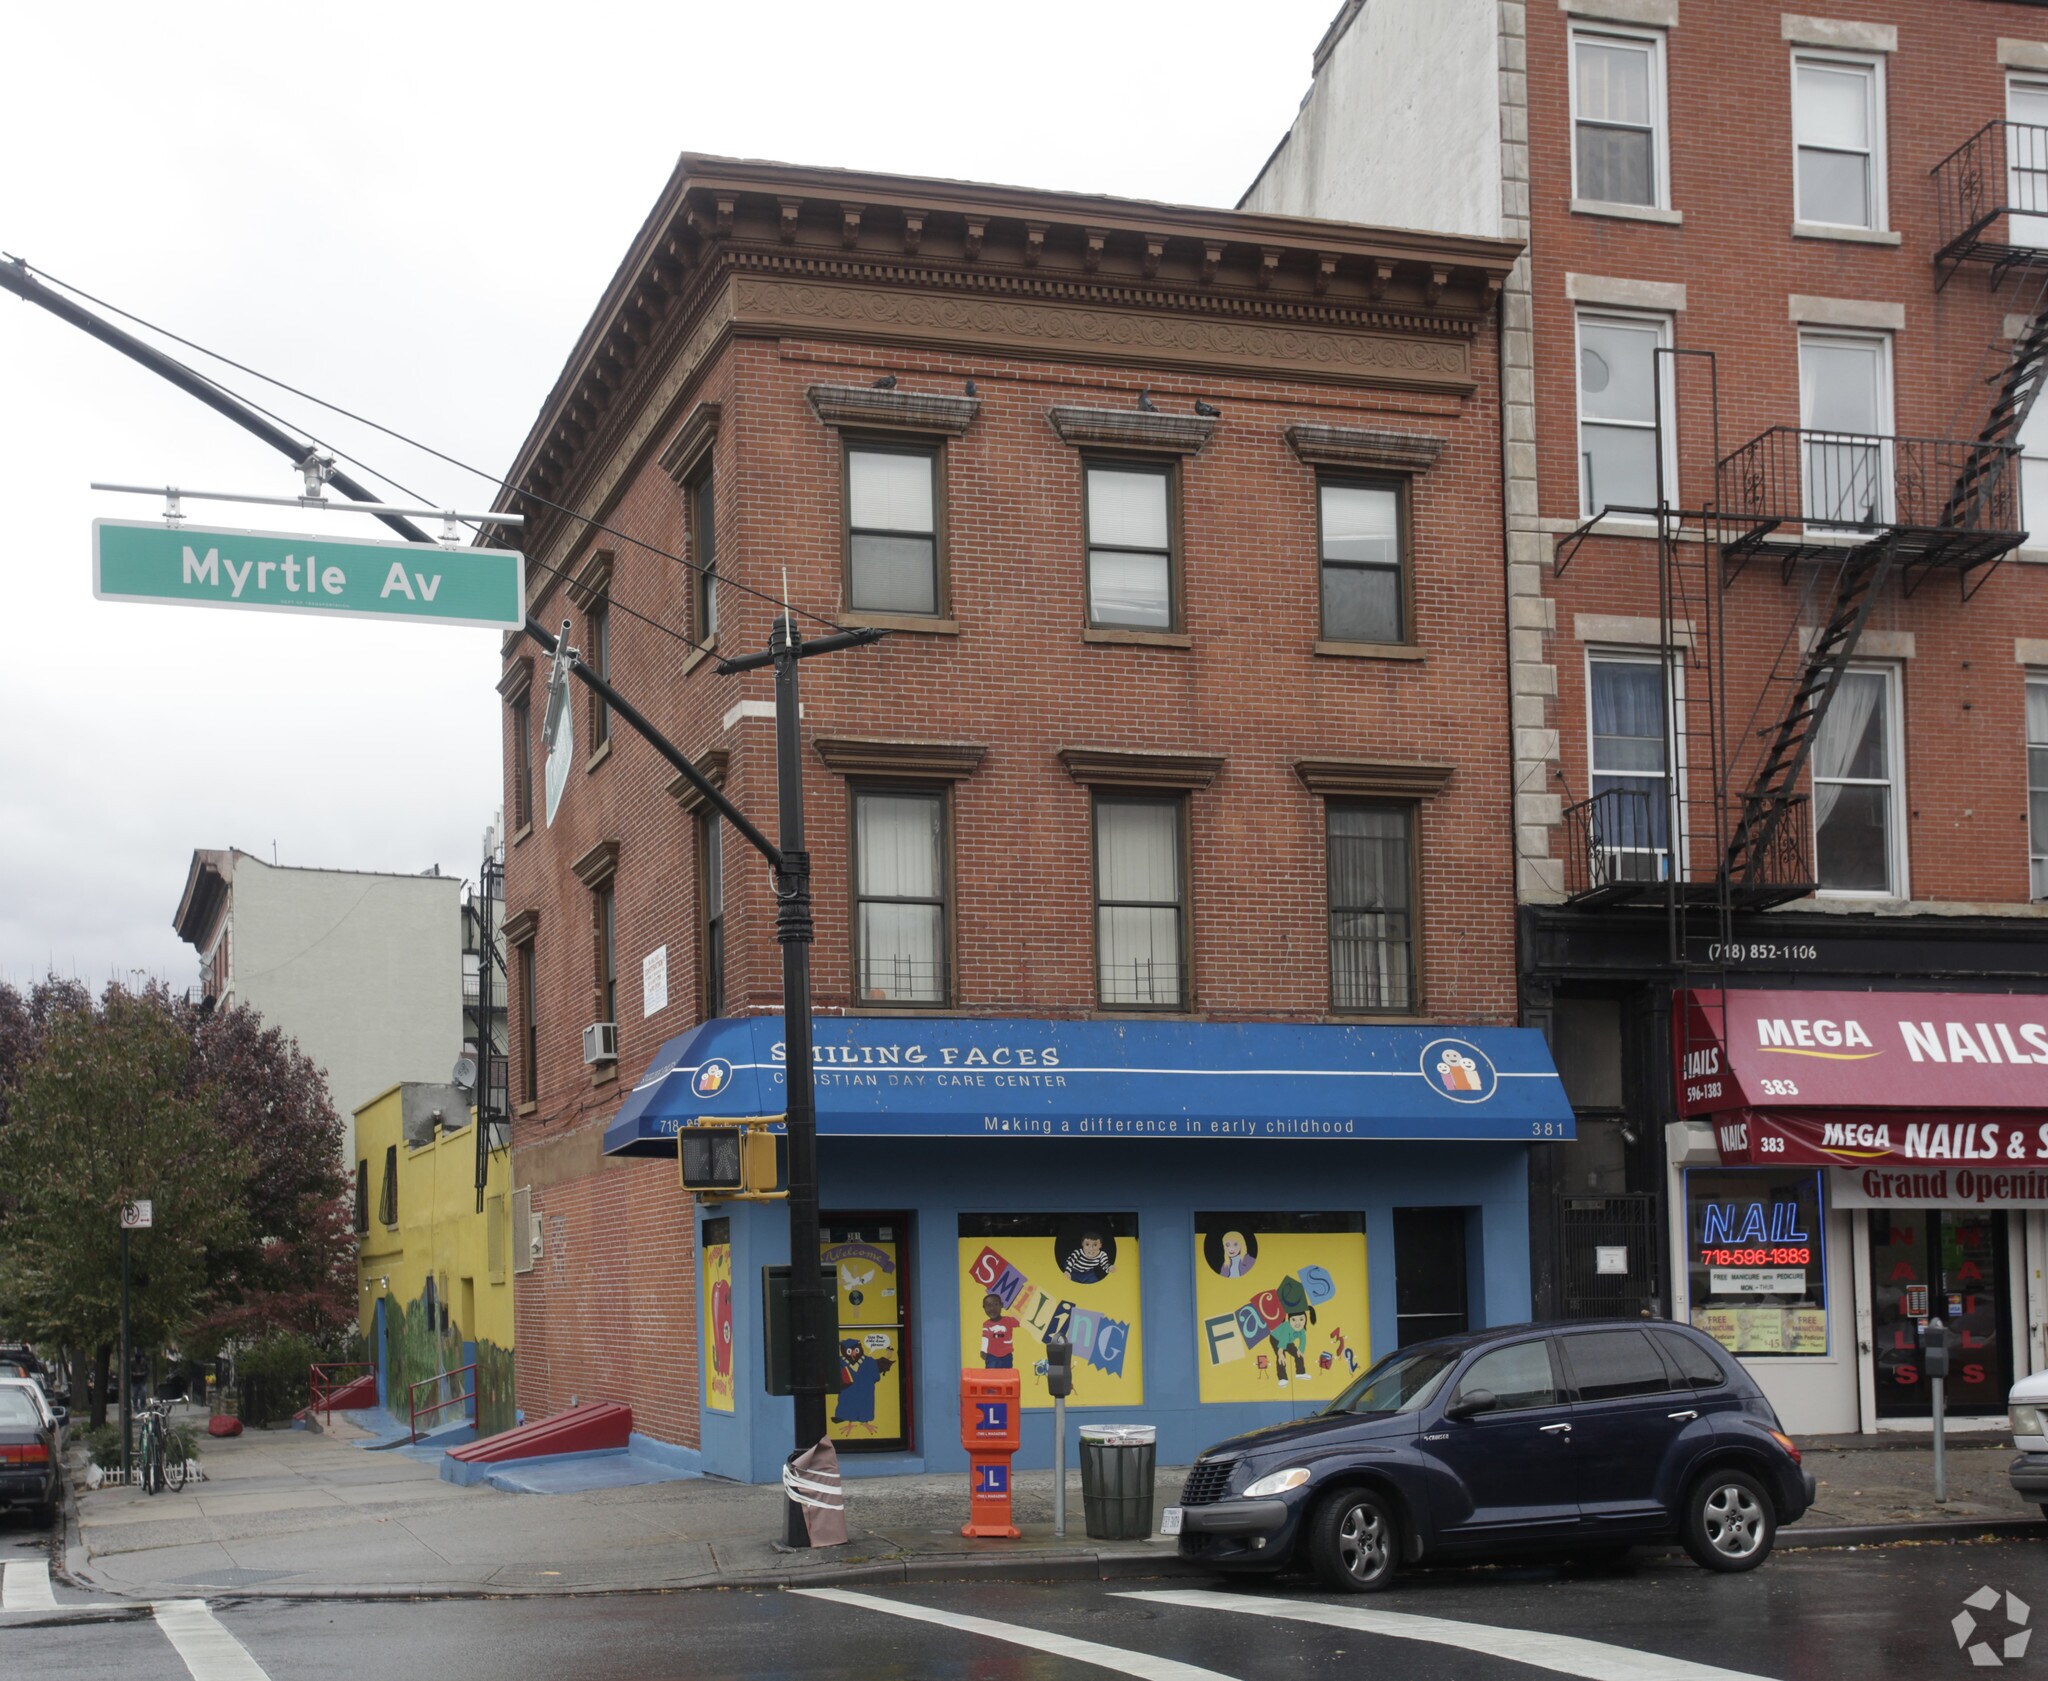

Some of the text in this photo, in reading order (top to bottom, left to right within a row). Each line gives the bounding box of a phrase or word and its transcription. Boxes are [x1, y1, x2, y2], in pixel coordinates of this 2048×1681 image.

[182, 546, 442, 601] Myrtle Av
[1708, 944, 1817, 962] (718) 852-1106
[1757, 1019, 2048, 1065] MEGA NAILS
[940, 1047, 1060, 1066] FACES
[773, 1072, 1067, 1087] CISTIAN DAY CARE CENTER
[1760, 1079, 1799, 1096] 383
[1687, 1082, 1722, 1102] 596-1383
[984, 1117, 1354, 1135] Making a difference in early childhood
[1532, 1122, 1564, 1136] 381
[1720, 1123, 1748, 1152] NAILS
[1760, 1137, 1785, 1153] 383
[1822, 1123, 1891, 1147] MEGA
[1904, 1123, 1999, 1158] NAILS
[2006, 1131, 2026, 1158] &
[1862, 1169, 1948, 1199] Grand
[1703, 1202, 1809, 1244] NAIL
[1701, 1248, 1811, 1266] 718-596-1383
[1707, 1316, 1727, 1324] FREE
[1798, 1316, 1817, 1325] FREE
[989, 1407, 1000, 1425] L
[989, 1470, 1000, 1487] L
